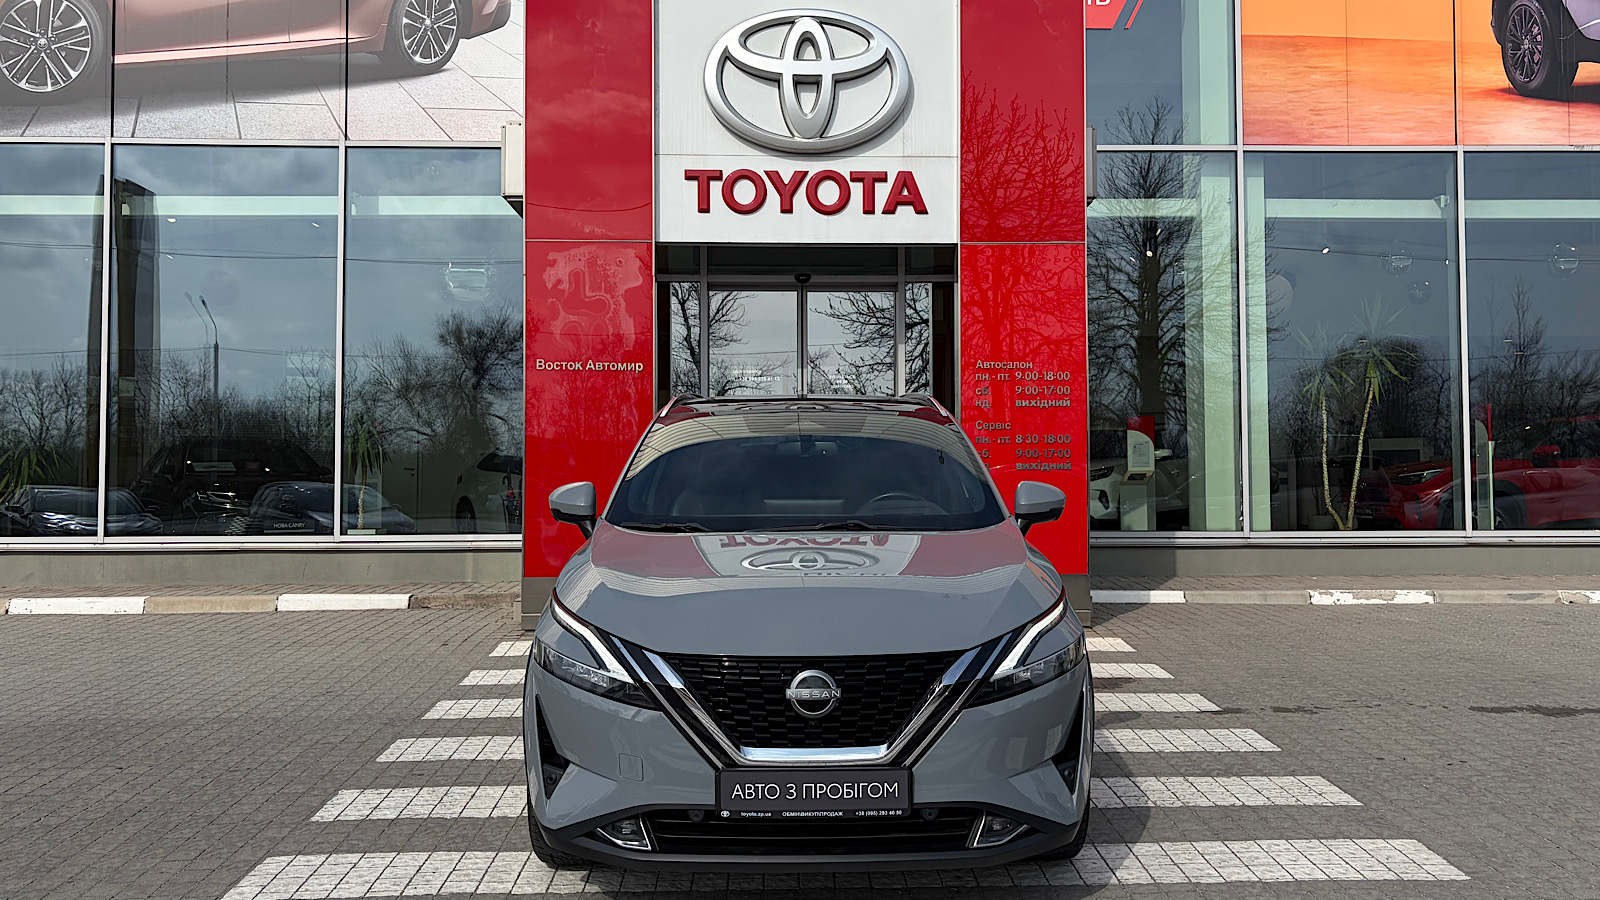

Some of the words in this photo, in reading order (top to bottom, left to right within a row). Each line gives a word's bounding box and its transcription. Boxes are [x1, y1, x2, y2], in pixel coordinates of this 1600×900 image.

[684, 168, 929, 215] TOYOTA
[536, 358, 583, 371] Восток
[586, 359, 644, 374] Автомир
[975, 359, 1033, 369] Автосалон
[975, 386, 992, 395] сб.
[1015, 385, 1071, 395] 9:00-17:00
[975, 399, 992, 408] нд.
[1015, 397, 1071, 409] вихідний
[975, 420, 1012, 431] Сервіс
[1015, 448, 1071, 458] 9:00-17:00
[1015, 460, 1072, 471] вихідний
[786, 689, 841, 698] NISSAN
[731, 783, 780, 800] АВТО
[802, 782, 899, 800] ПРОБІГОМ
